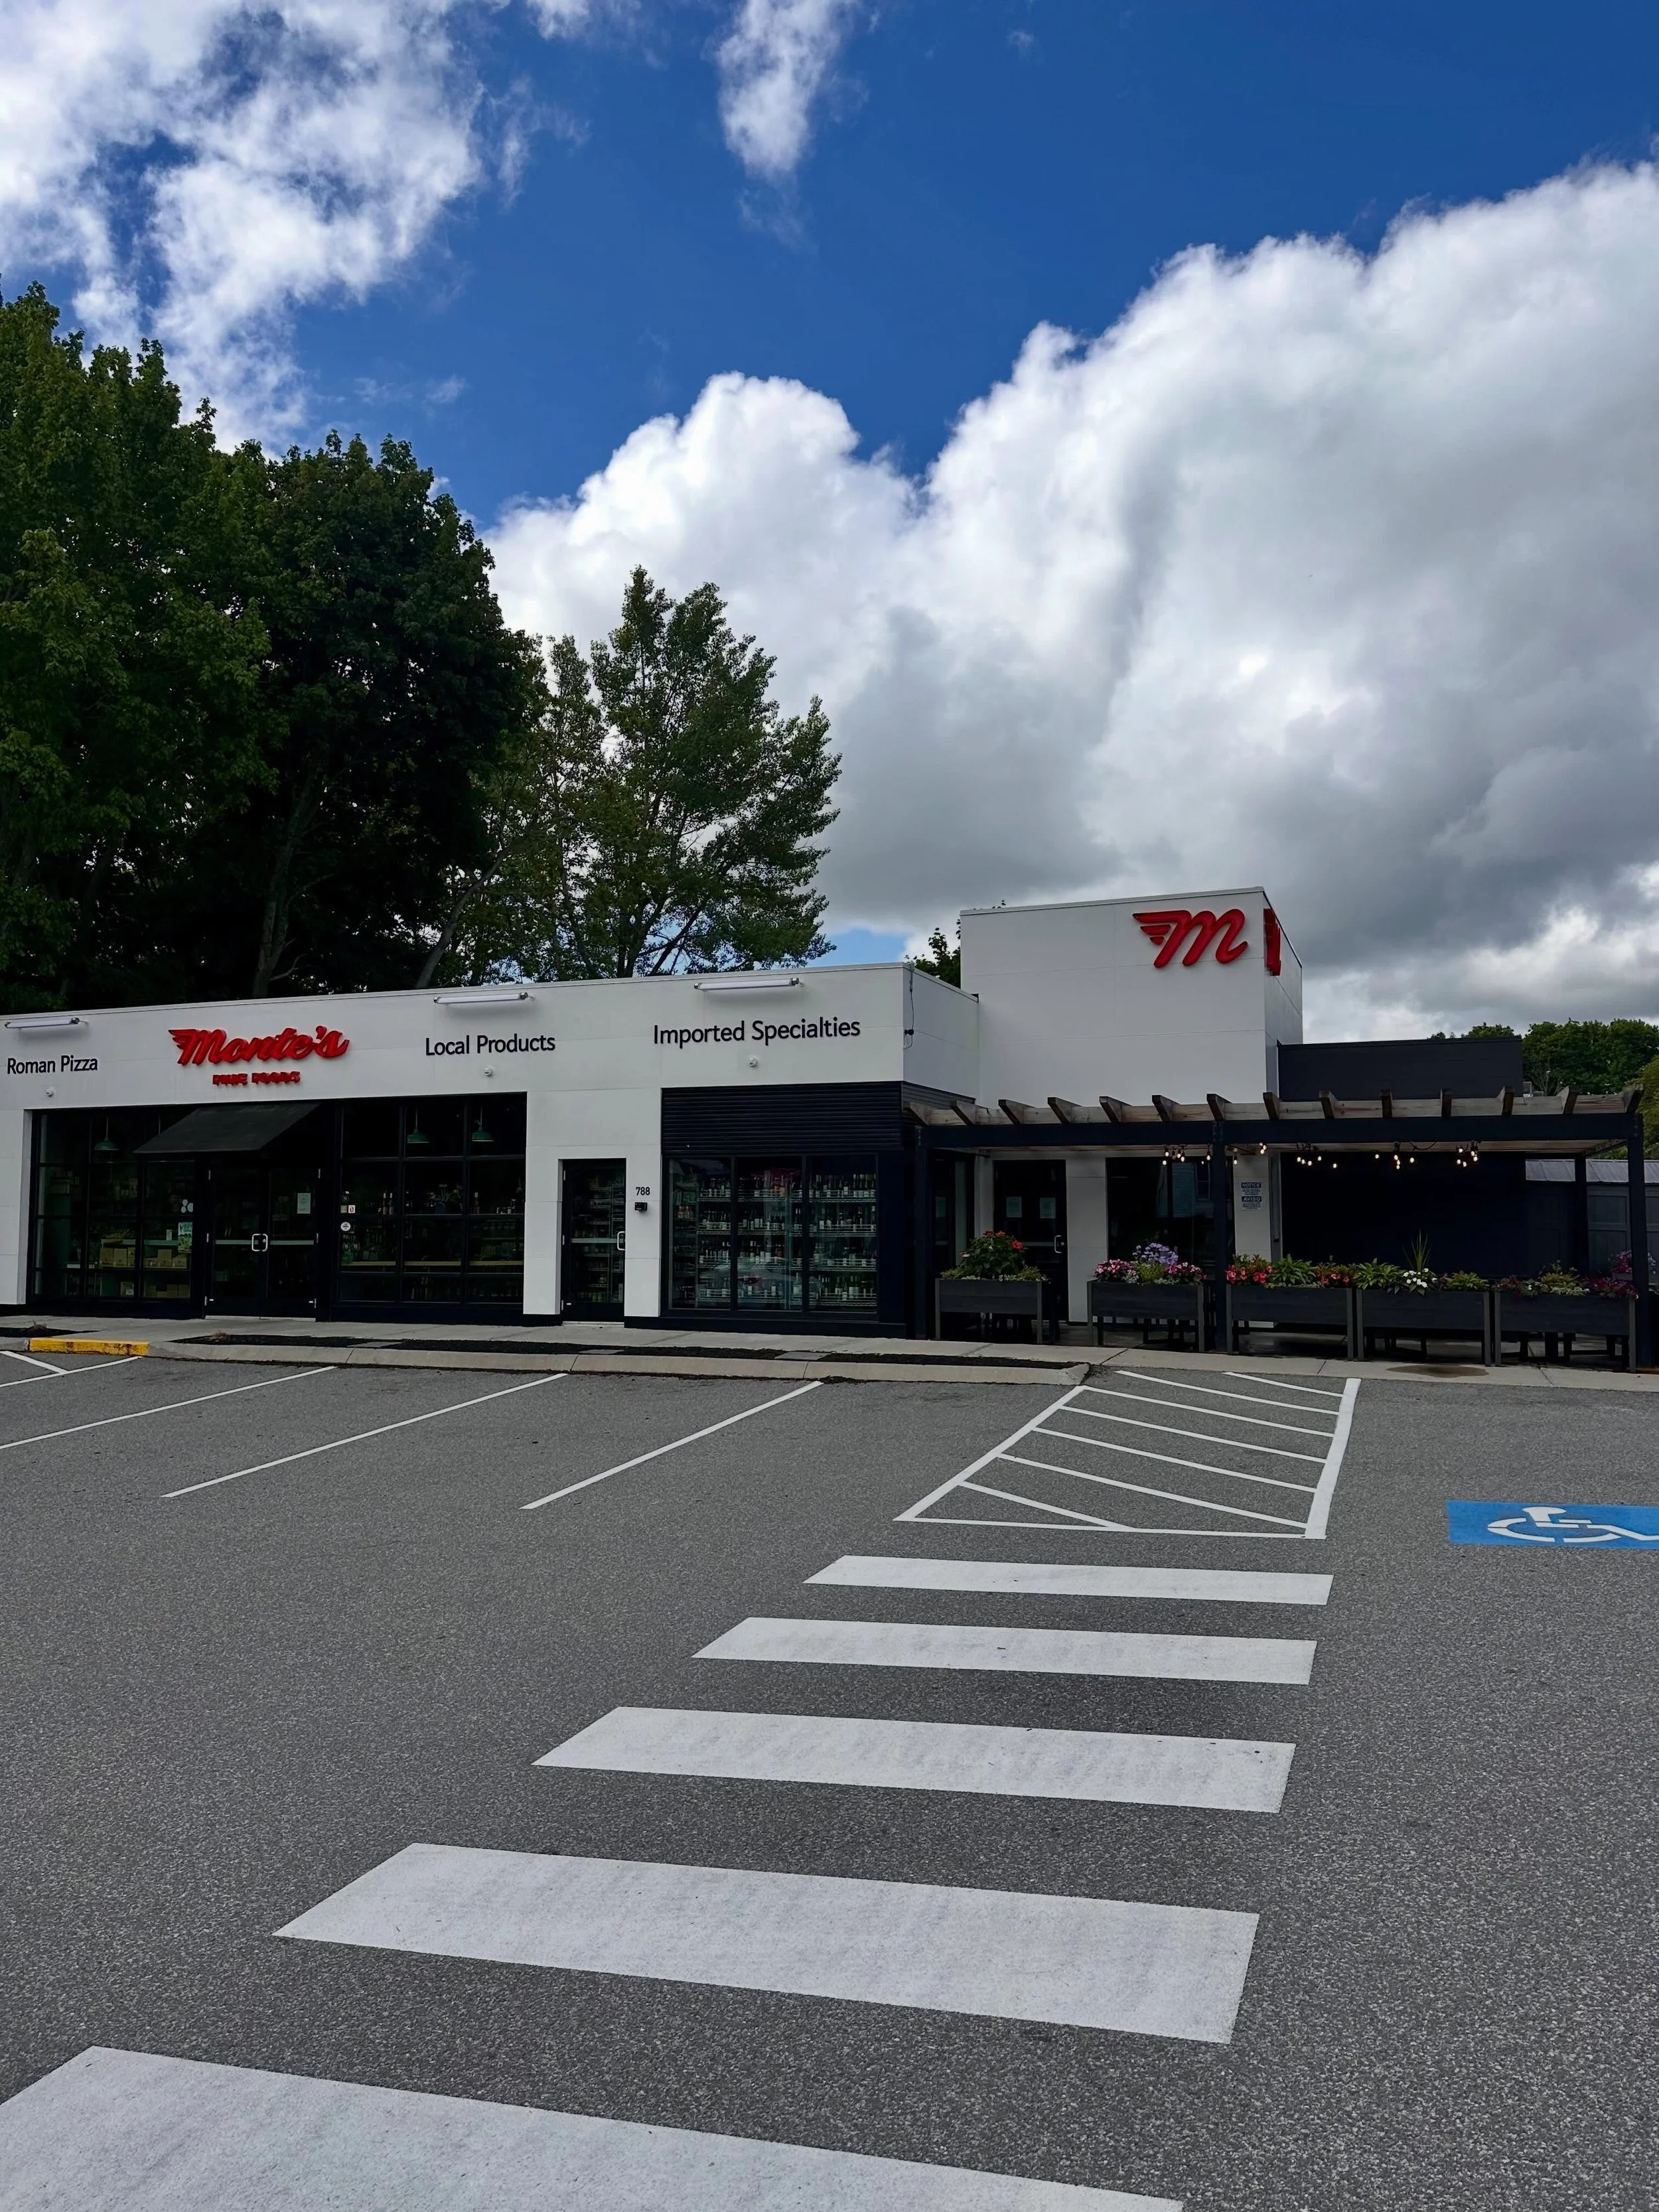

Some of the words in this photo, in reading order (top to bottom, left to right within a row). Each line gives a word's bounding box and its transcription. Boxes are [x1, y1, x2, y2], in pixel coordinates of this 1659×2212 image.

[425, 1035, 469, 1056] Local
[476, 1033, 555, 1054] Products
[654, 1020, 745, 1049] Imported
[751, 1017, 861, 1046] Specialties
[169, 1026, 350, 1065] Monte's
[7, 1058, 56, 1074] Roman
[60, 1055, 98, 1072] Pizza
[636, 1187, 650, 1195] 788
